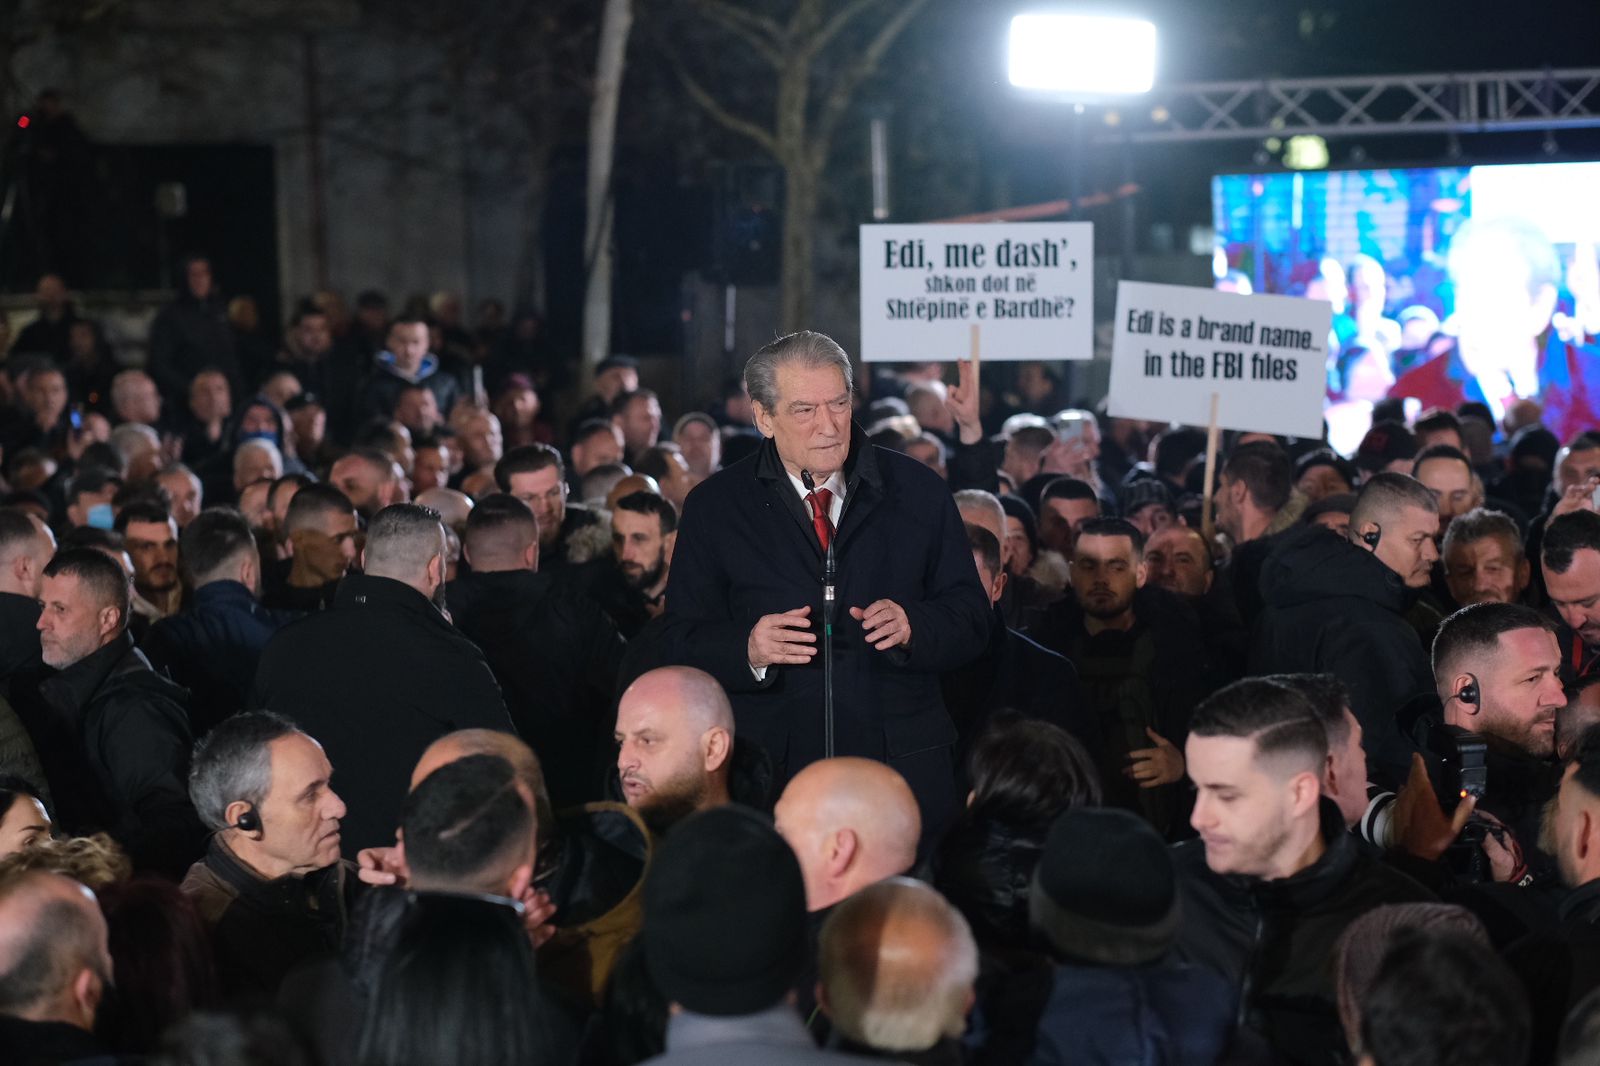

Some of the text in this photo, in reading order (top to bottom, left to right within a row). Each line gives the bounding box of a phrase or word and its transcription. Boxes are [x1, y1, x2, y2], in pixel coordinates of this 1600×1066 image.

[884, 239, 934, 271] Edi,
[945, 244, 986, 268] me
[925, 273, 1036, 293] shkon dot në
[886, 296, 1074, 321] Shtëpinë e Bardhë?
[1127, 309, 1153, 334] Edi
[1159, 312, 1175, 337] is
[1181, 317, 1192, 339] a
[1198, 316, 1254, 344] brand
[1144, 351, 1297, 381] in the FBI files
